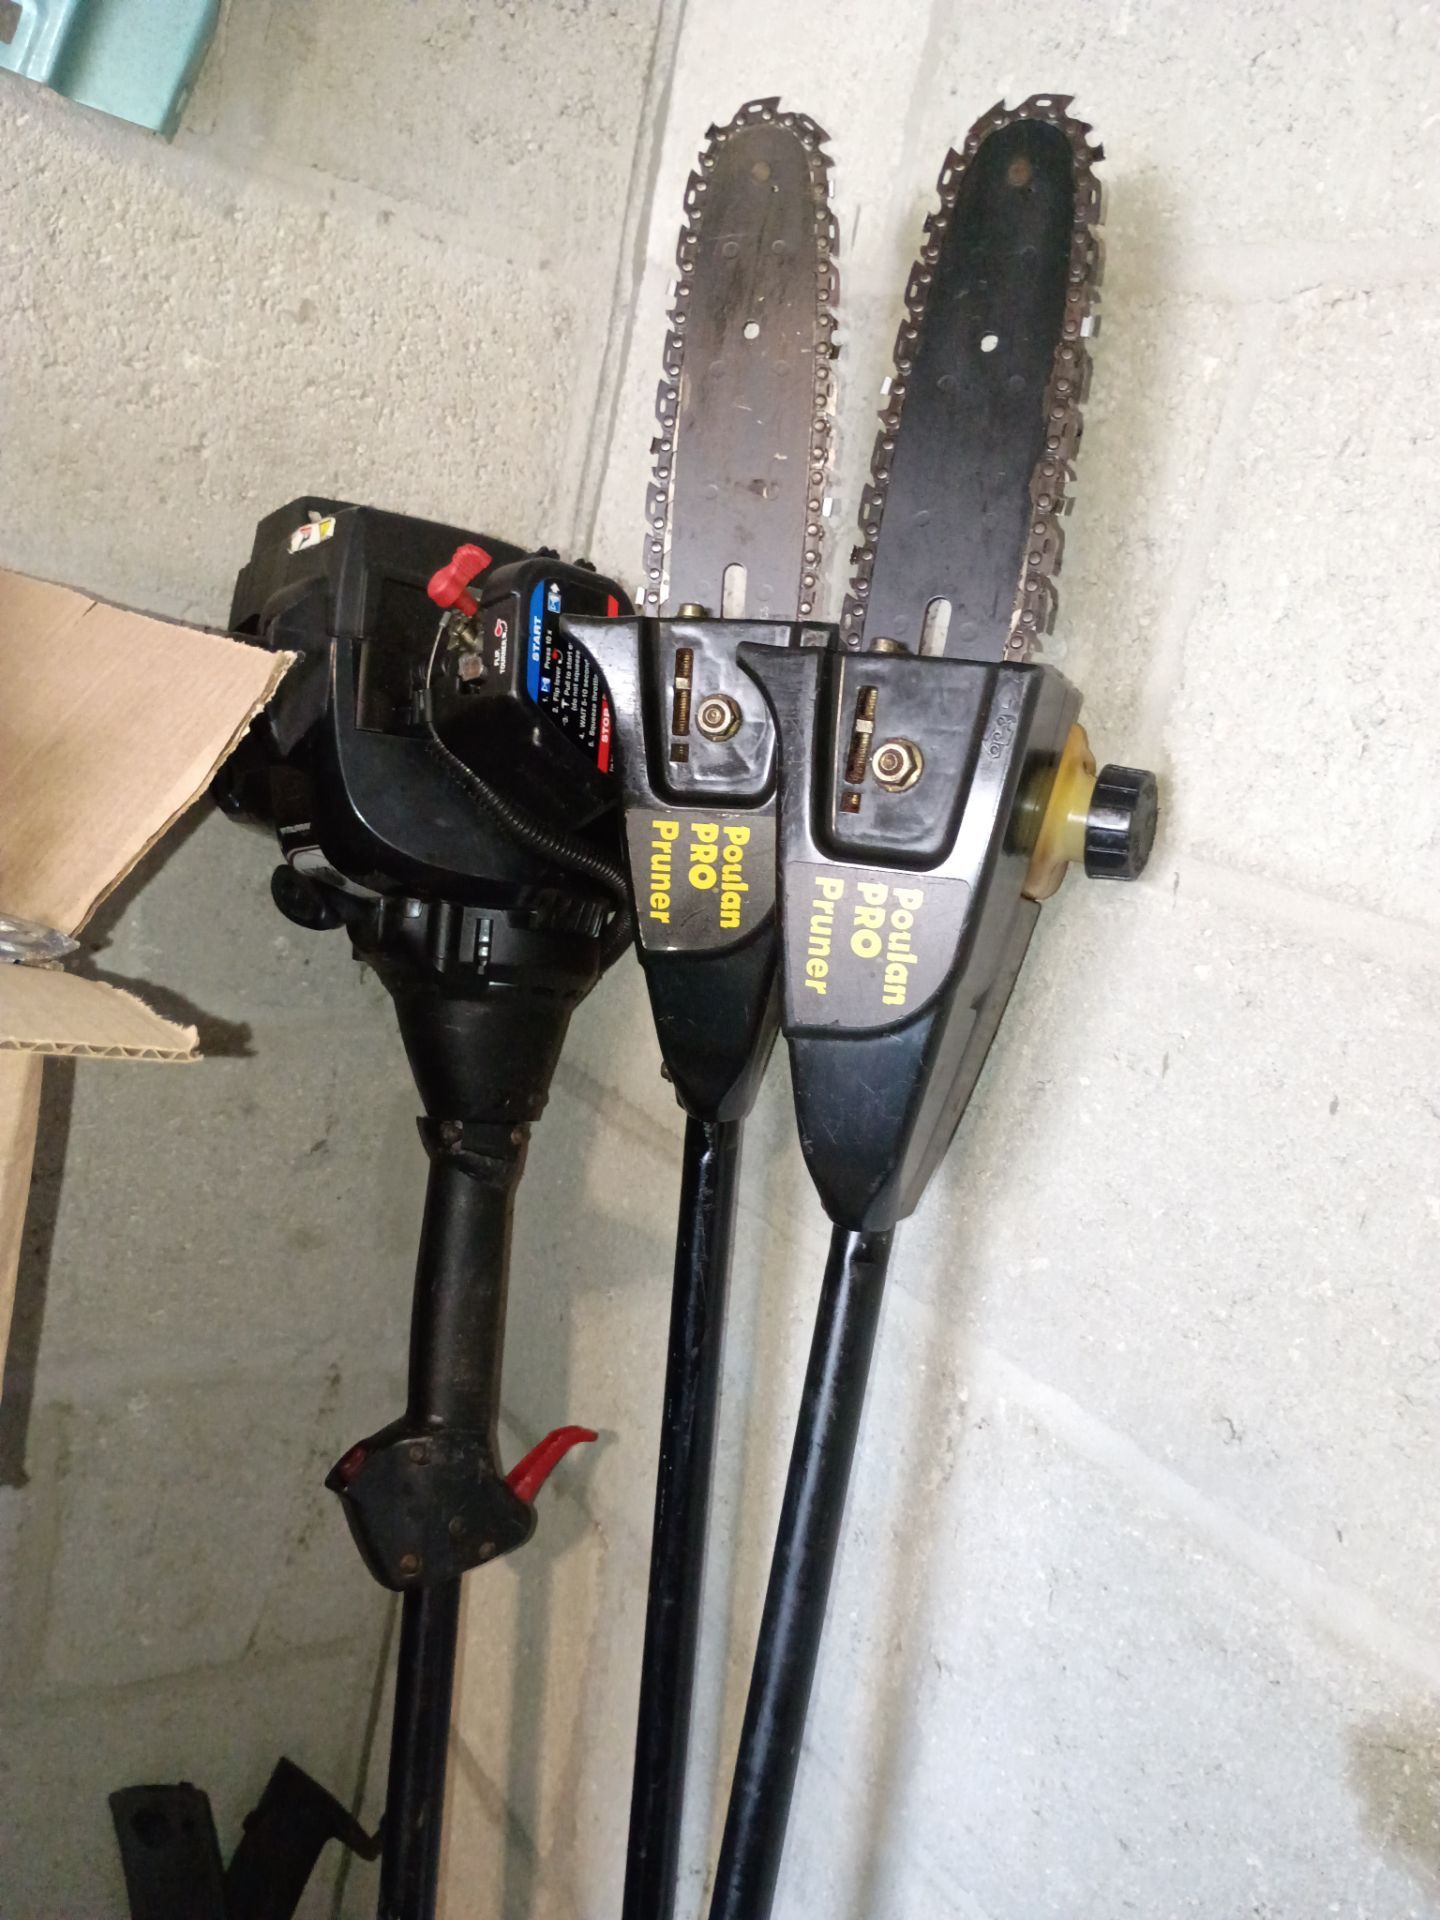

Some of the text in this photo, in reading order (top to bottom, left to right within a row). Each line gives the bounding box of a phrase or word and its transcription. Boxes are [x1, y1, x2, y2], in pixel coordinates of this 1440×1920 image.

[532, 615, 542, 662] START
[545, 635, 552, 645] 10
[544, 647, 552, 669] Press
[565, 651, 573, 670] start
[573, 650, 581, 682] squeeze
[563, 681, 571, 696] Pull
[565, 671, 571, 680] to
[552, 687, 560, 702] Flip
[579, 707, 587, 728] WAIT
[589, 703, 597, 736] Squeeze
[601, 707, 610, 743] STOP
[649, 819, 680, 924] Pruner
[688, 822, 719, 890] PRO
[719, 826, 751, 929] Poulan
[804, 876, 844, 995] Pruner
[849, 882, 888, 959] PRO
[882, 888, 924, 1006] Poulan
